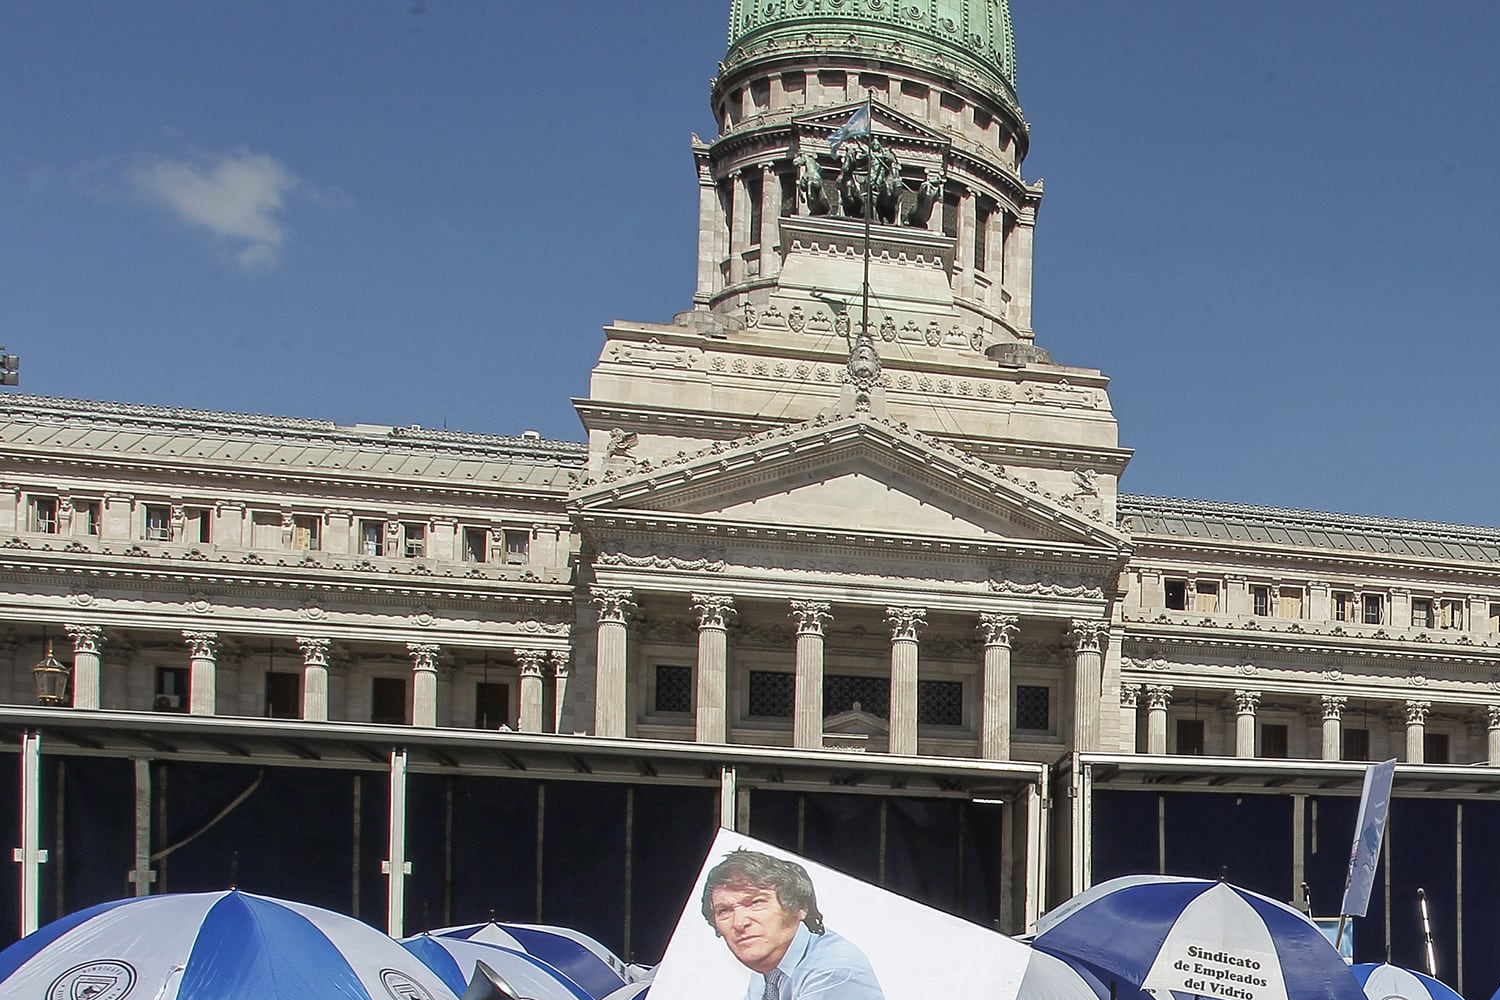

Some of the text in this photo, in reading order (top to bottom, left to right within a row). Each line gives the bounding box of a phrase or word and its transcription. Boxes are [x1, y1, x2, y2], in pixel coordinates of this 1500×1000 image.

[1187, 945, 1261, 970] Sindicato
[1174, 960, 1267, 987] de Empleados
[1184, 978, 1254, 1000] del Vidrio
